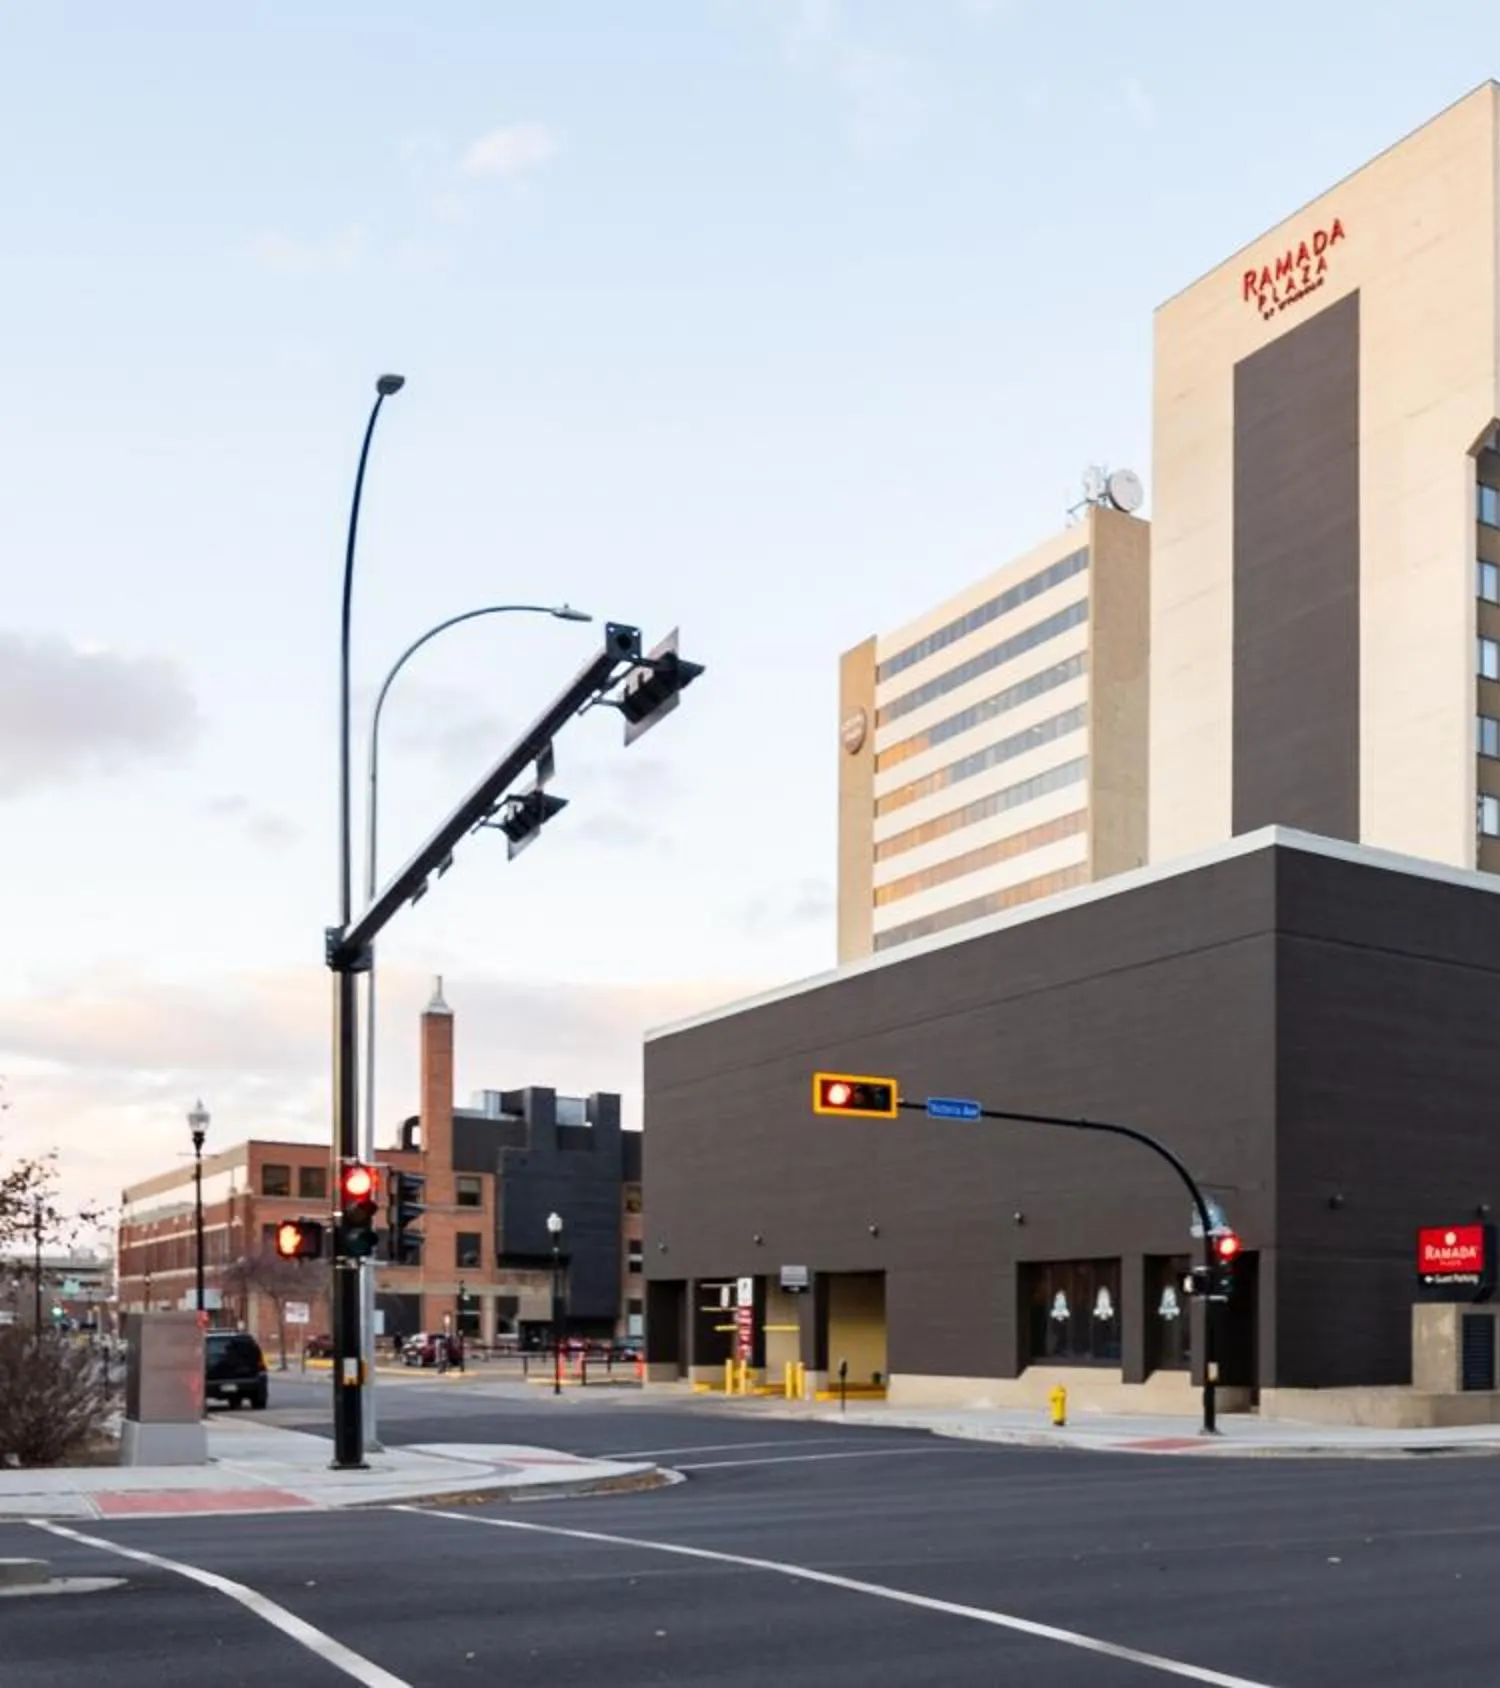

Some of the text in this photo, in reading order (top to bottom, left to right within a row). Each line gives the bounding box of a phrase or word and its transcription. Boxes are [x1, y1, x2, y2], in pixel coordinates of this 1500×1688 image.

[1243, 217, 1345, 302] RAMADA
[1258, 256, 1328, 312] PLAZA
[1424, 1244, 1477, 1261] RAMADA
